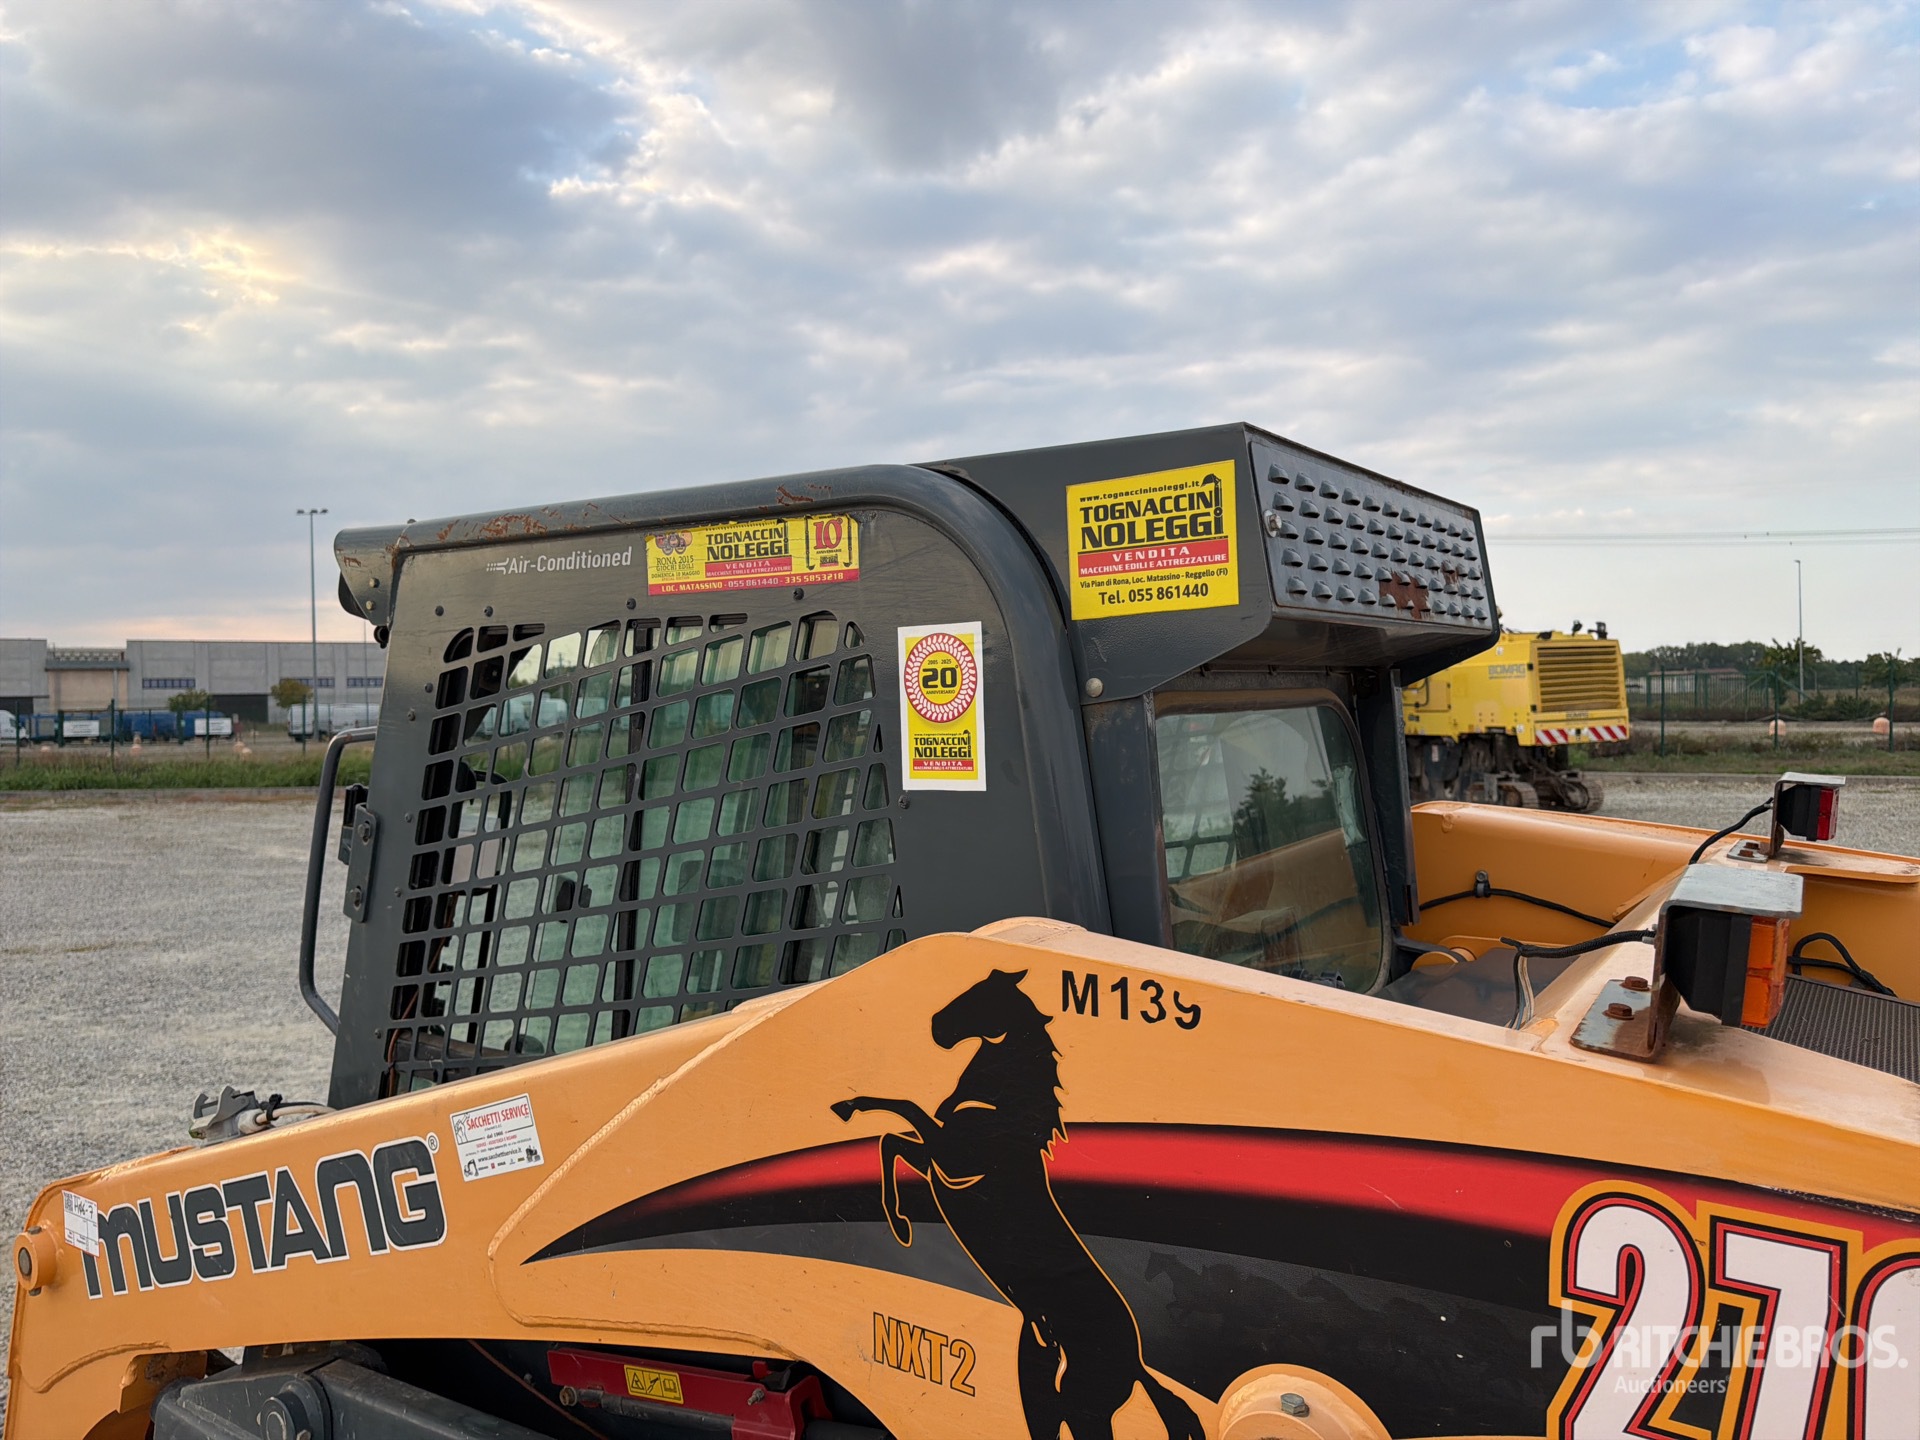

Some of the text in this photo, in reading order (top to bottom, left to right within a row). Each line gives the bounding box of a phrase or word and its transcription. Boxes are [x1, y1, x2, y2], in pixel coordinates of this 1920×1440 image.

[1080, 480, 1200, 502] www.tognaccininoleggi.it
[508, 546, 632, 574] Air-Conditioned
[656, 554, 694, 566] RONA 2015
[725, 560, 771, 570] VENDITA
[1080, 564, 1123, 575] MACCHINE
[1125, 562, 1148, 570] EDILI
[1156, 553, 1227, 568] ATTREZZATURE
[1112, 546, 1190, 562] VENDITA
[661, 584, 678, 593] LOC.
[679, 581, 723, 592] MATASSINO
[728, 580, 744, 588] 055
[746, 577, 779, 587] 861440
[785, 576, 802, 584] 335
[1080, 580, 1090, 588] Via
[1091, 579, 1105, 588] Pian
[1106, 579, 1112, 587] di
[1113, 577, 1131, 586] Rona,
[1132, 575, 1145, 584] Loc.
[1146, 572, 1181, 583] Matassino
[1185, 569, 1215, 580] Reggello
[1098, 582, 1209, 605] Tel. 055 861440
[1062, 970, 1099, 1017] M
[466, 1103, 529, 1131] SACCHETTI SERVICE
[82, 1138, 447, 1299] MUSTANG
[873, 1311, 976, 1397] NXT2
